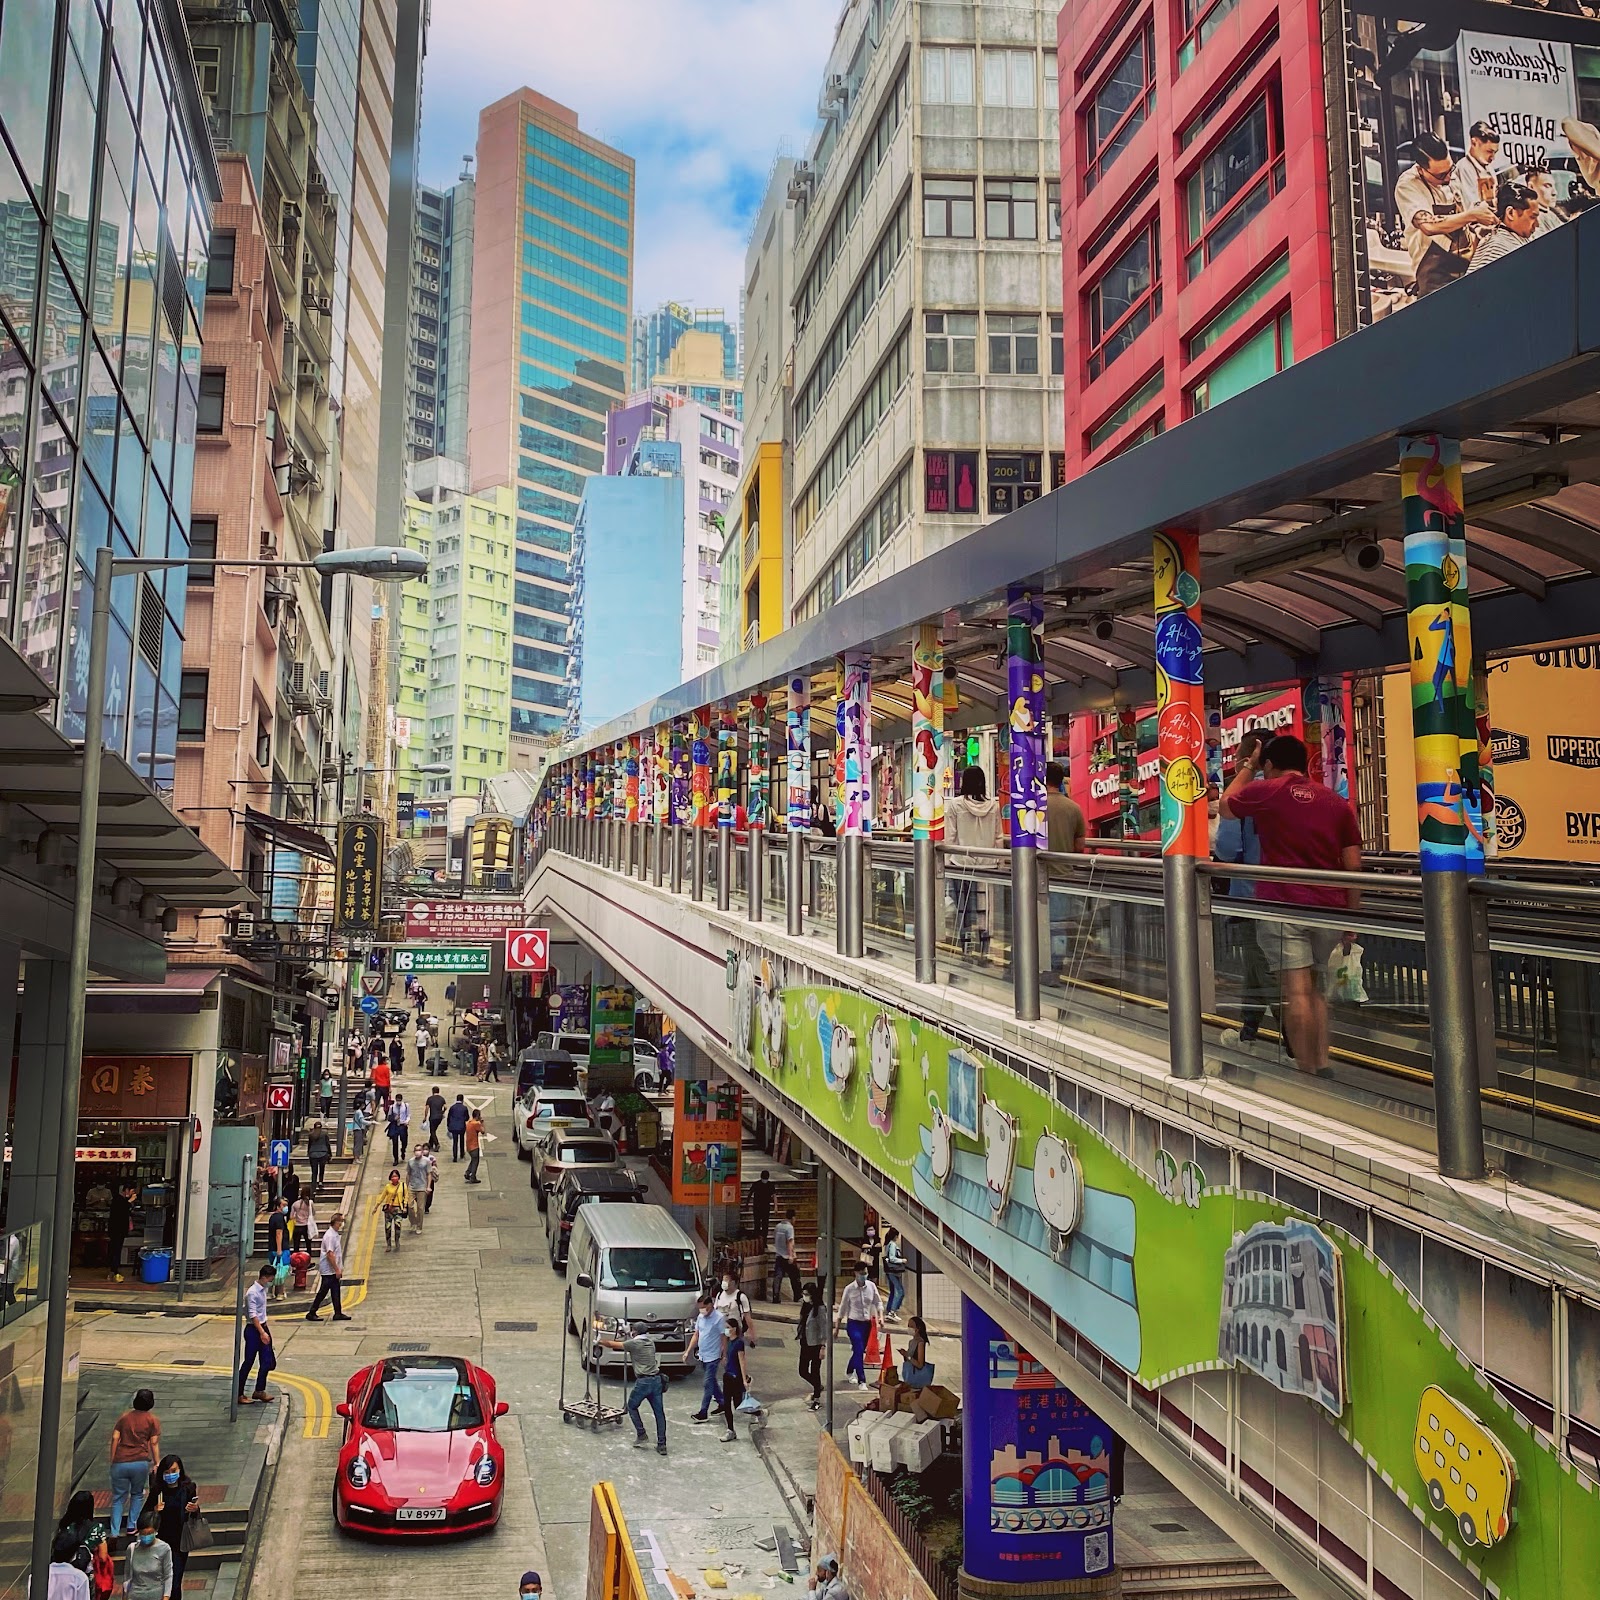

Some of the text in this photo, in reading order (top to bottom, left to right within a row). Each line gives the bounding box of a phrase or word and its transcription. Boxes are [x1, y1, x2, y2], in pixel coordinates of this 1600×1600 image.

[994, 467, 1019, 477] 200+
[353, 826, 367, 868] 春回堂
[399, 1509, 443, 1519] LV 8997
